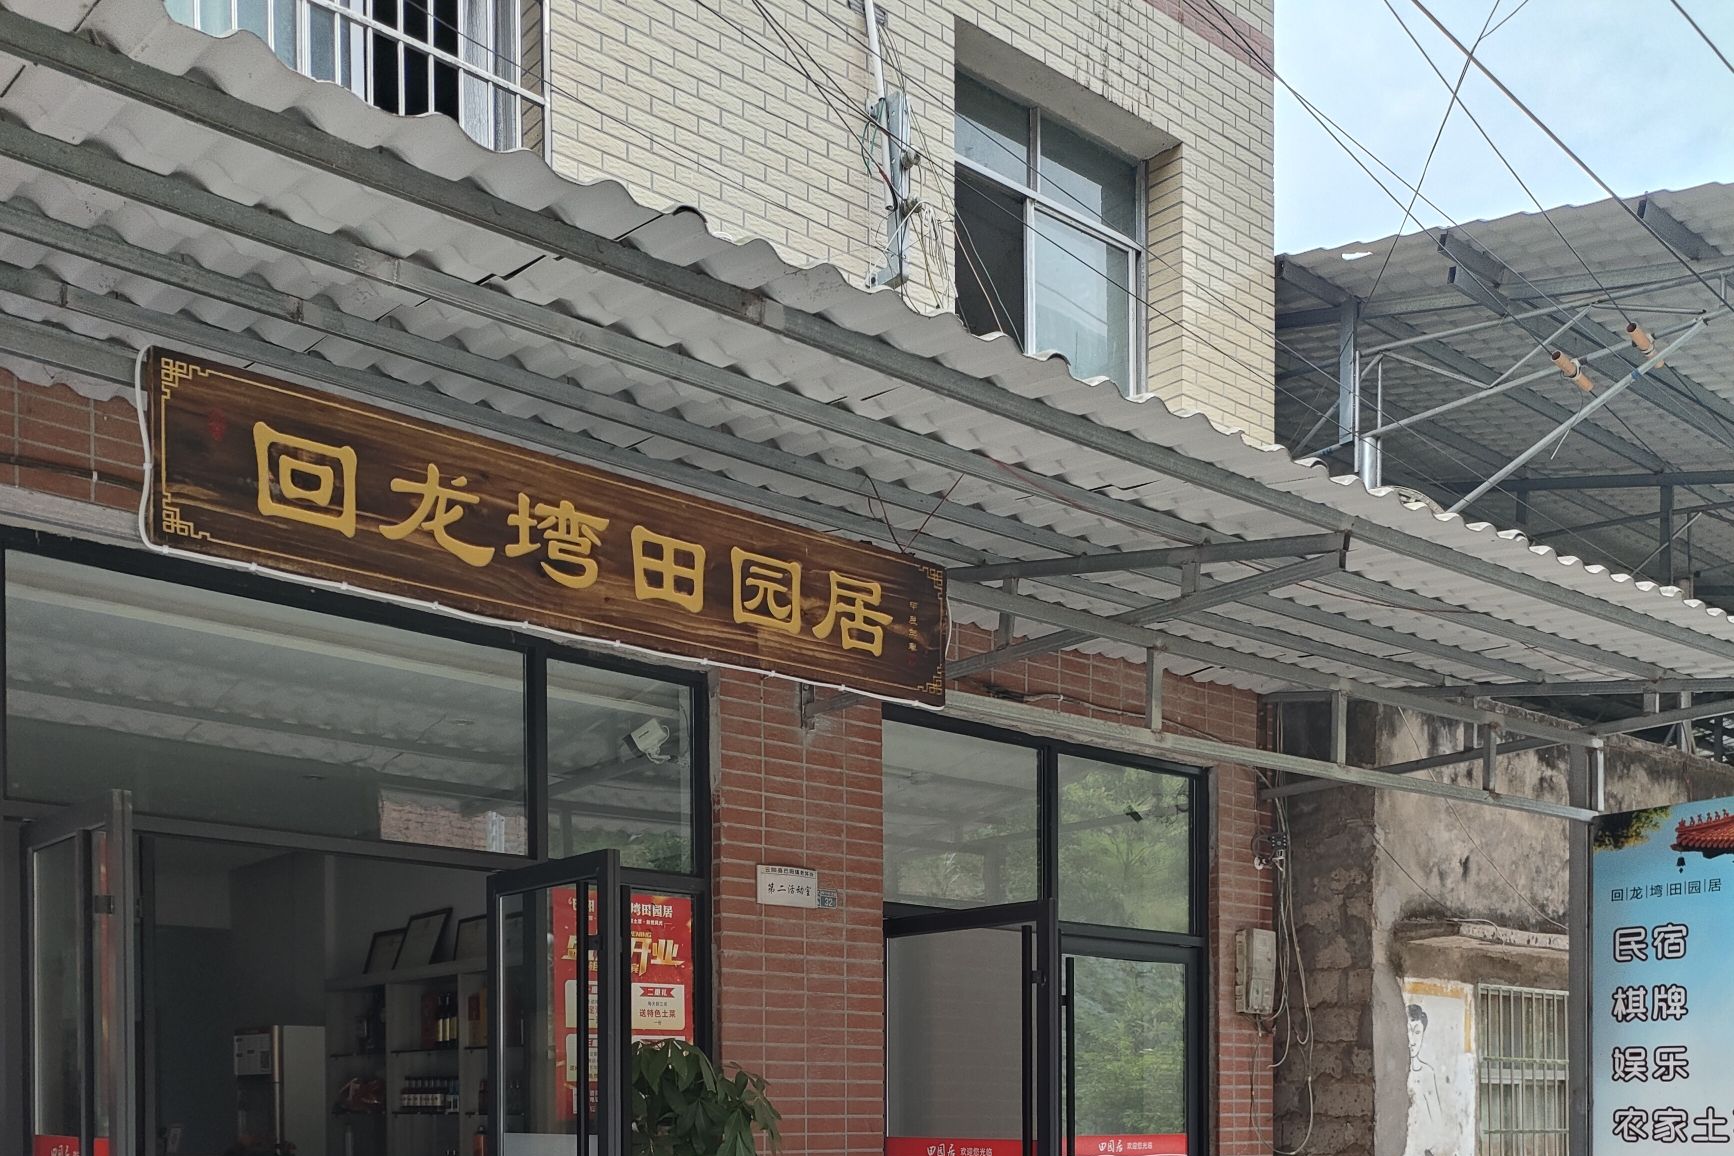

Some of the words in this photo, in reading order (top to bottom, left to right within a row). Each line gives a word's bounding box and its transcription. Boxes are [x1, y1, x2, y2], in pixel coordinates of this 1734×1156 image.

[767, 882, 812, 896] 第二活动室
[1613, 922, 1689, 963] 民宿
[1611, 984, 1689, 1022] 棋牌
[1611, 1046, 1690, 1082] 娱乐
[1612, 1106, 1734, 1143] 农家土
